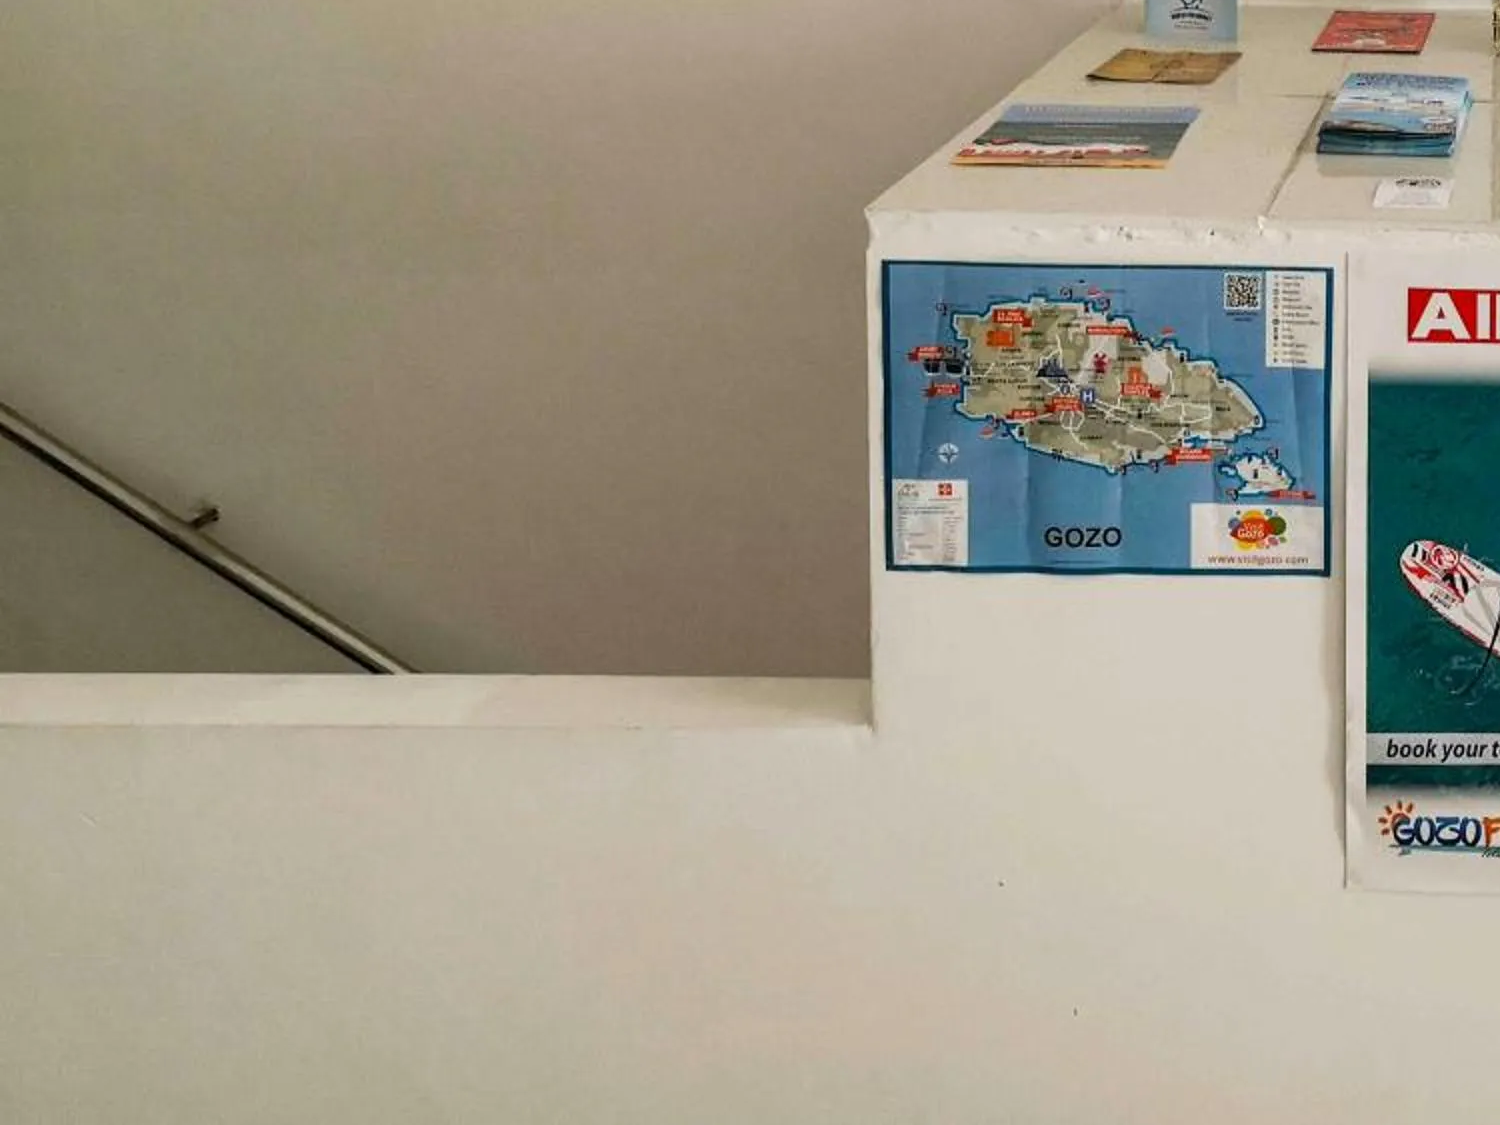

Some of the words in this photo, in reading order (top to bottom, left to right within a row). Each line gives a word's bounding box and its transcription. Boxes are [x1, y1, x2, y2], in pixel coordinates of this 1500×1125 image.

[1043, 525, 1122, 549] GOZO
[1387, 739, 1436, 758] book
[1440, 743, 1489, 764] your
